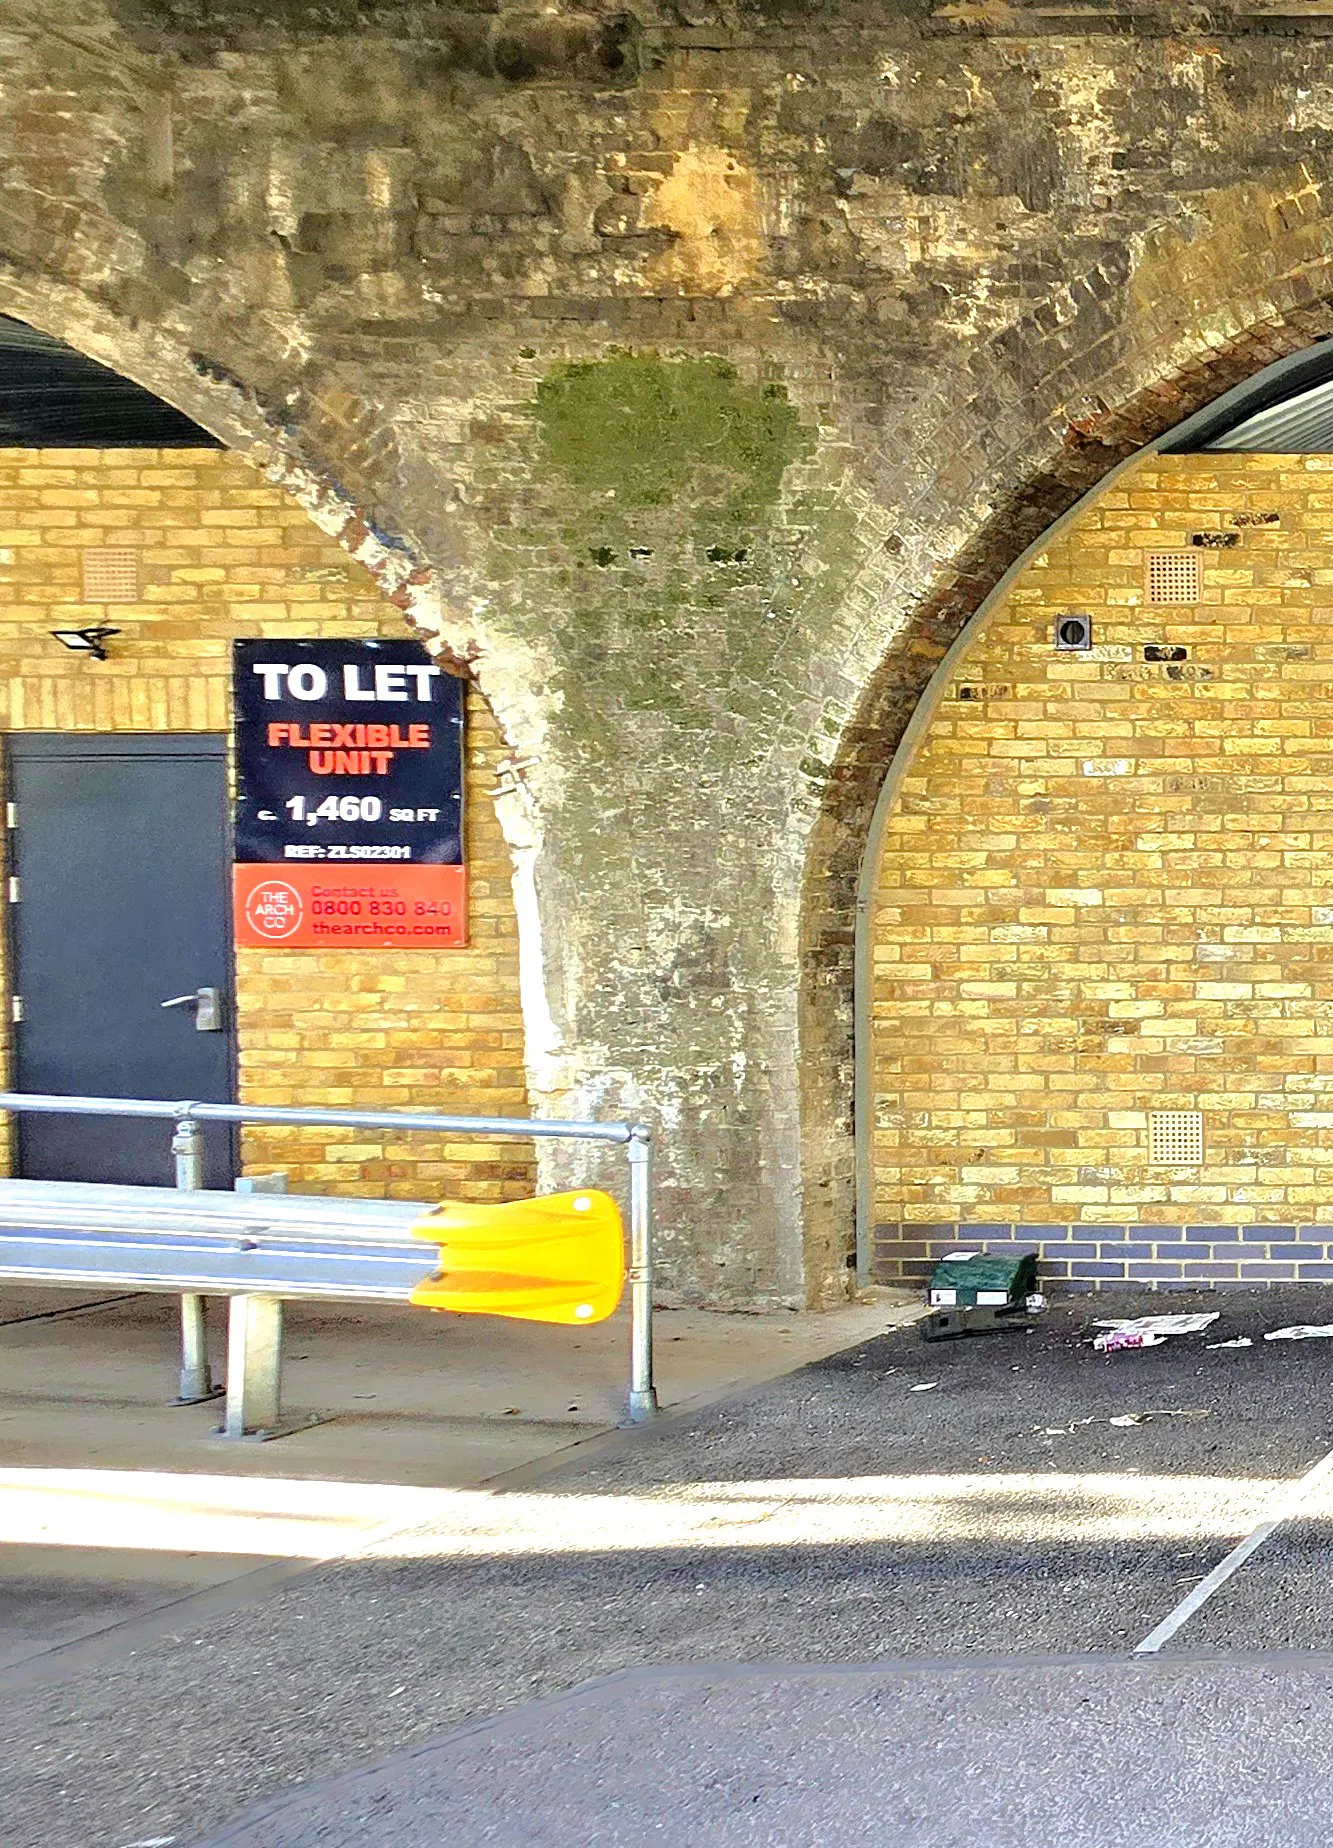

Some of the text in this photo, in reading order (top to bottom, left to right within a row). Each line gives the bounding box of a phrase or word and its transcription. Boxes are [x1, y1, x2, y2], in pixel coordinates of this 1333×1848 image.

[253, 663, 440, 701] TO LET
[268, 723, 430, 748] FLEXIBLE
[309, 751, 394, 774] UNIT
[286, 795, 381, 826] 1,460
[389, 809, 415, 822] SQ
[417, 809, 440, 821] FT
[285, 845, 411, 859] REF: ZLS02301
[261, 891, 287, 903] THE
[311, 885, 399, 898] Contact us
[255, 904, 294, 916] ARCH
[311, 900, 451, 916] 0800 830 840
[263, 916, 285, 928] CO
[312, 922, 451, 936] thearchco.com
